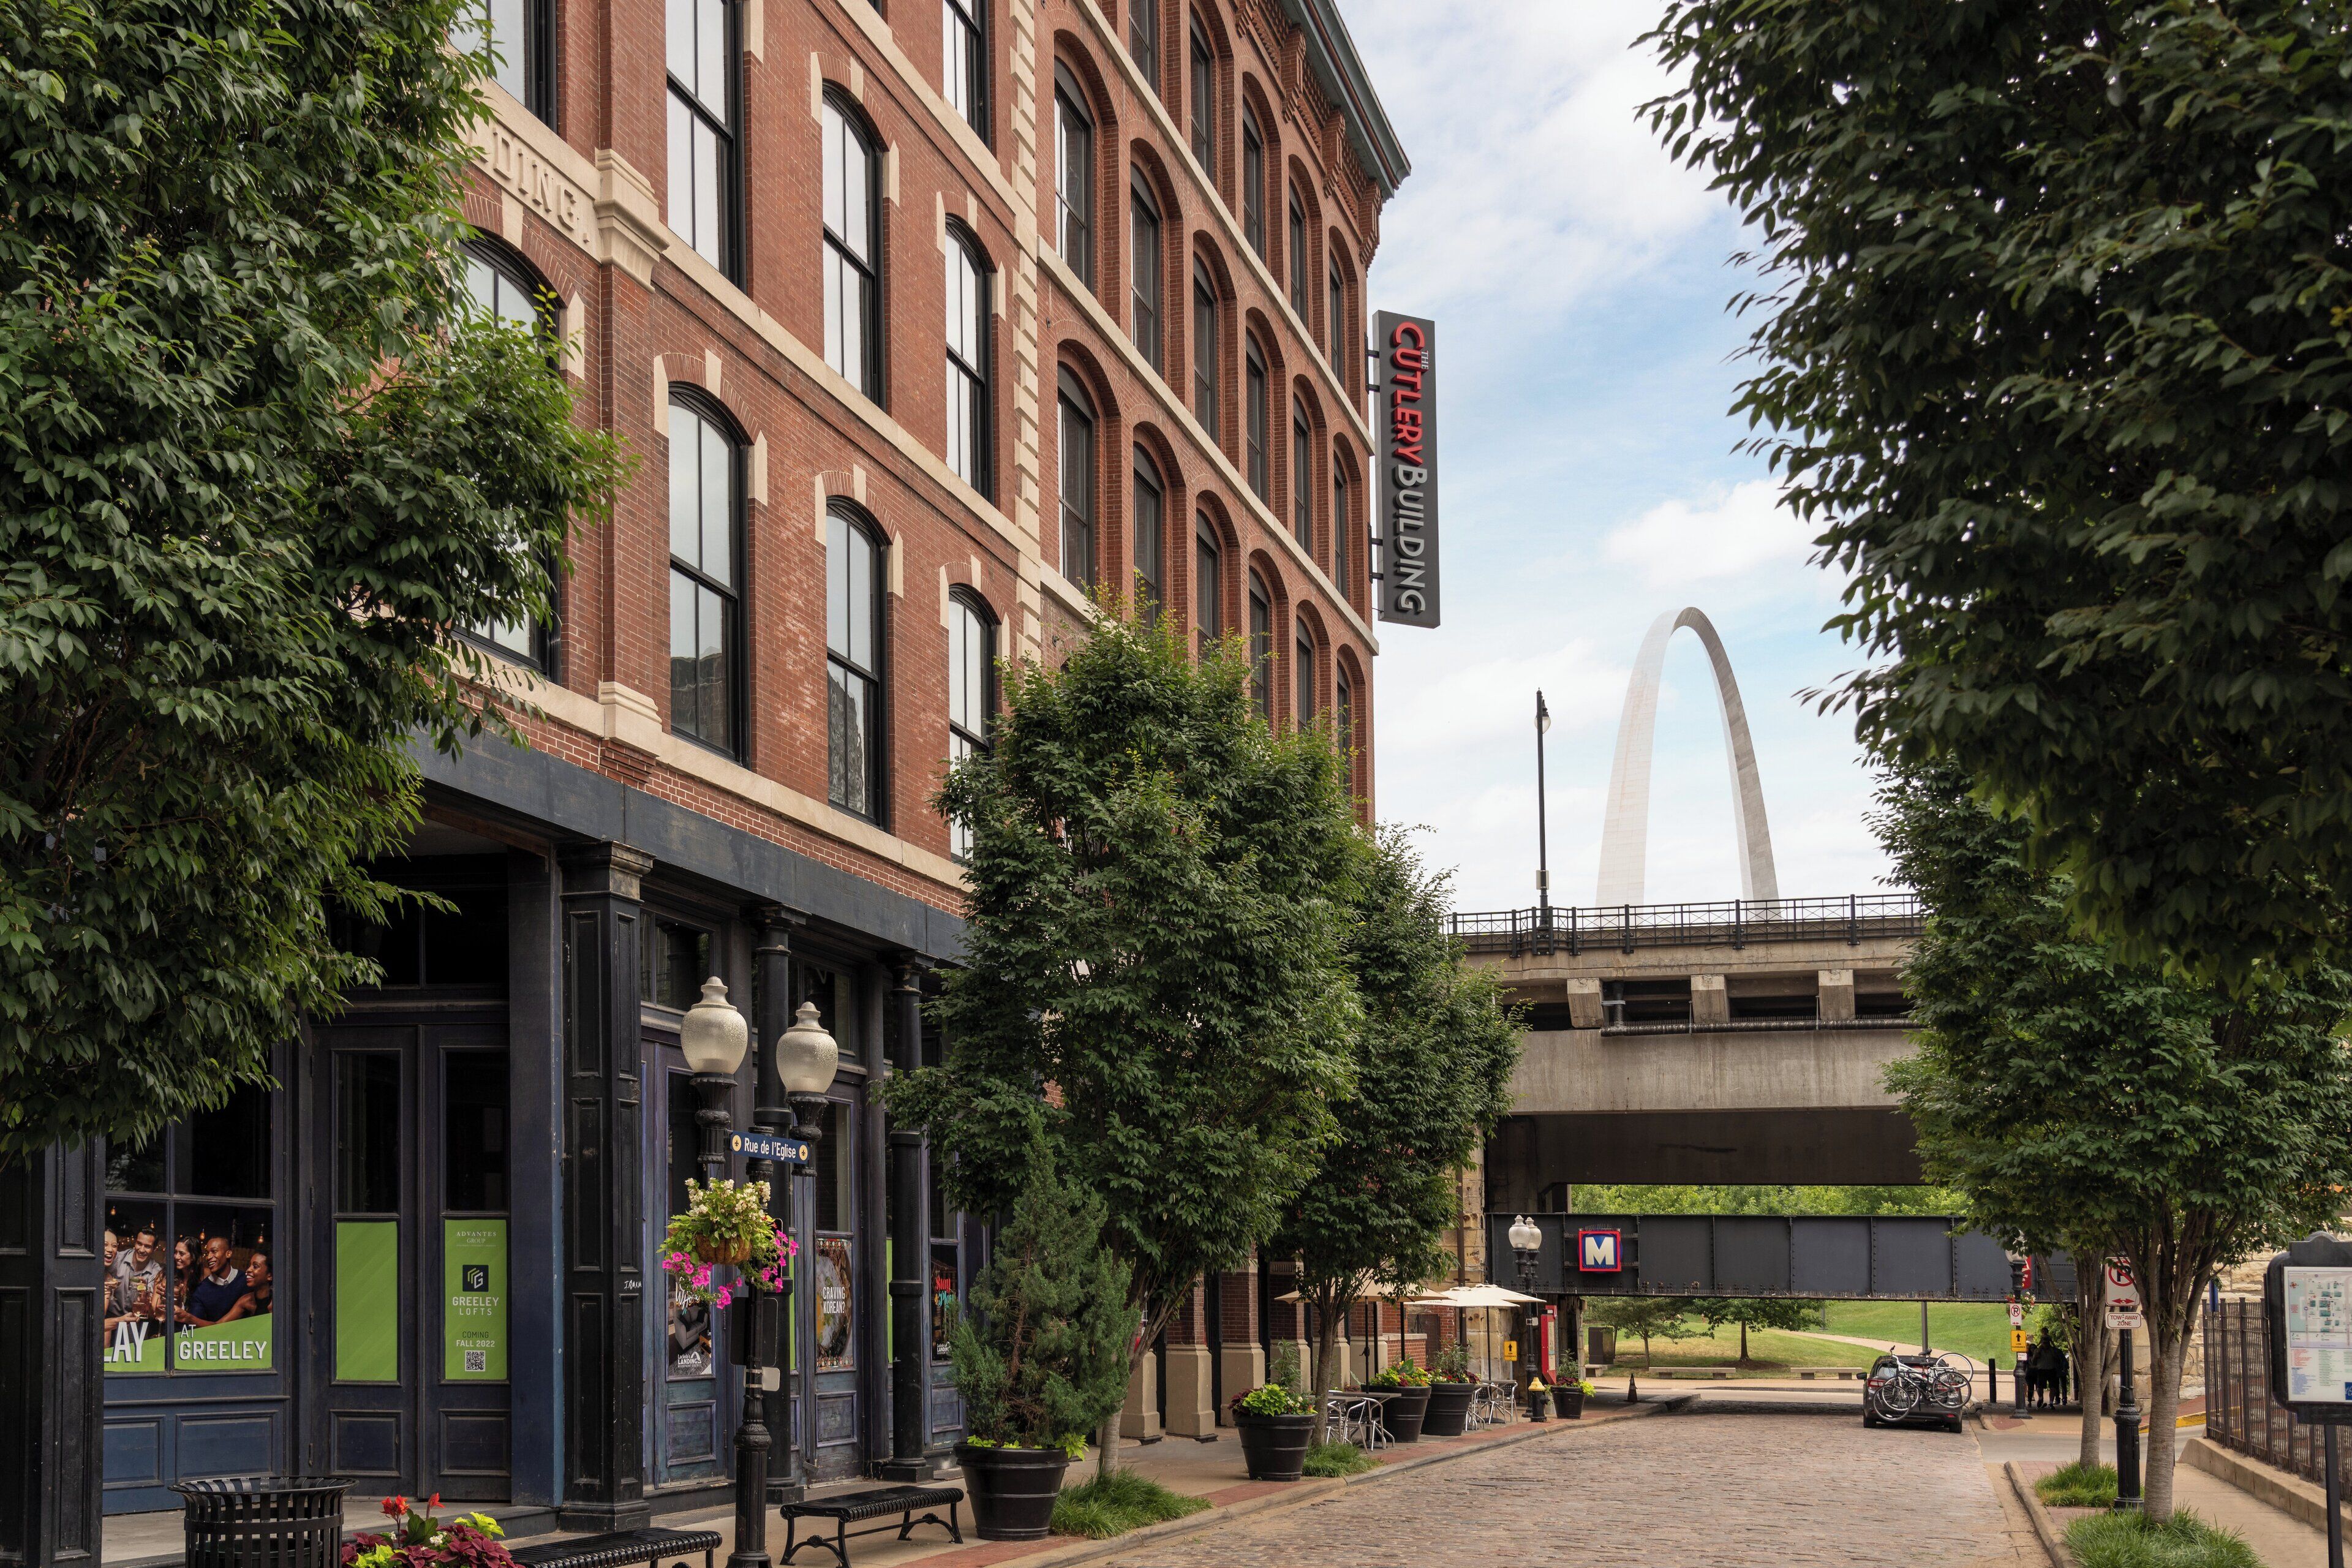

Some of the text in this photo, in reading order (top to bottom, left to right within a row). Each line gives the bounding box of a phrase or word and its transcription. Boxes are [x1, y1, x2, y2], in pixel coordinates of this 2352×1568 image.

[1392, 320, 1428, 614] CUTLERY BUILDING
[744, 1137, 758, 1153] Rue
[760, 1140, 770, 1155] de
[1585, 1237, 1615, 1265] M
[452, 1296, 499, 1306] GREELEY
[823, 1286, 845, 1300] CRAVING
[823, 1301, 845, 1314] KOREAN?
[180, 1324, 197, 1338] AT
[104, 1321, 149, 1362] AY
[179, 1340, 268, 1360] GREELEY
